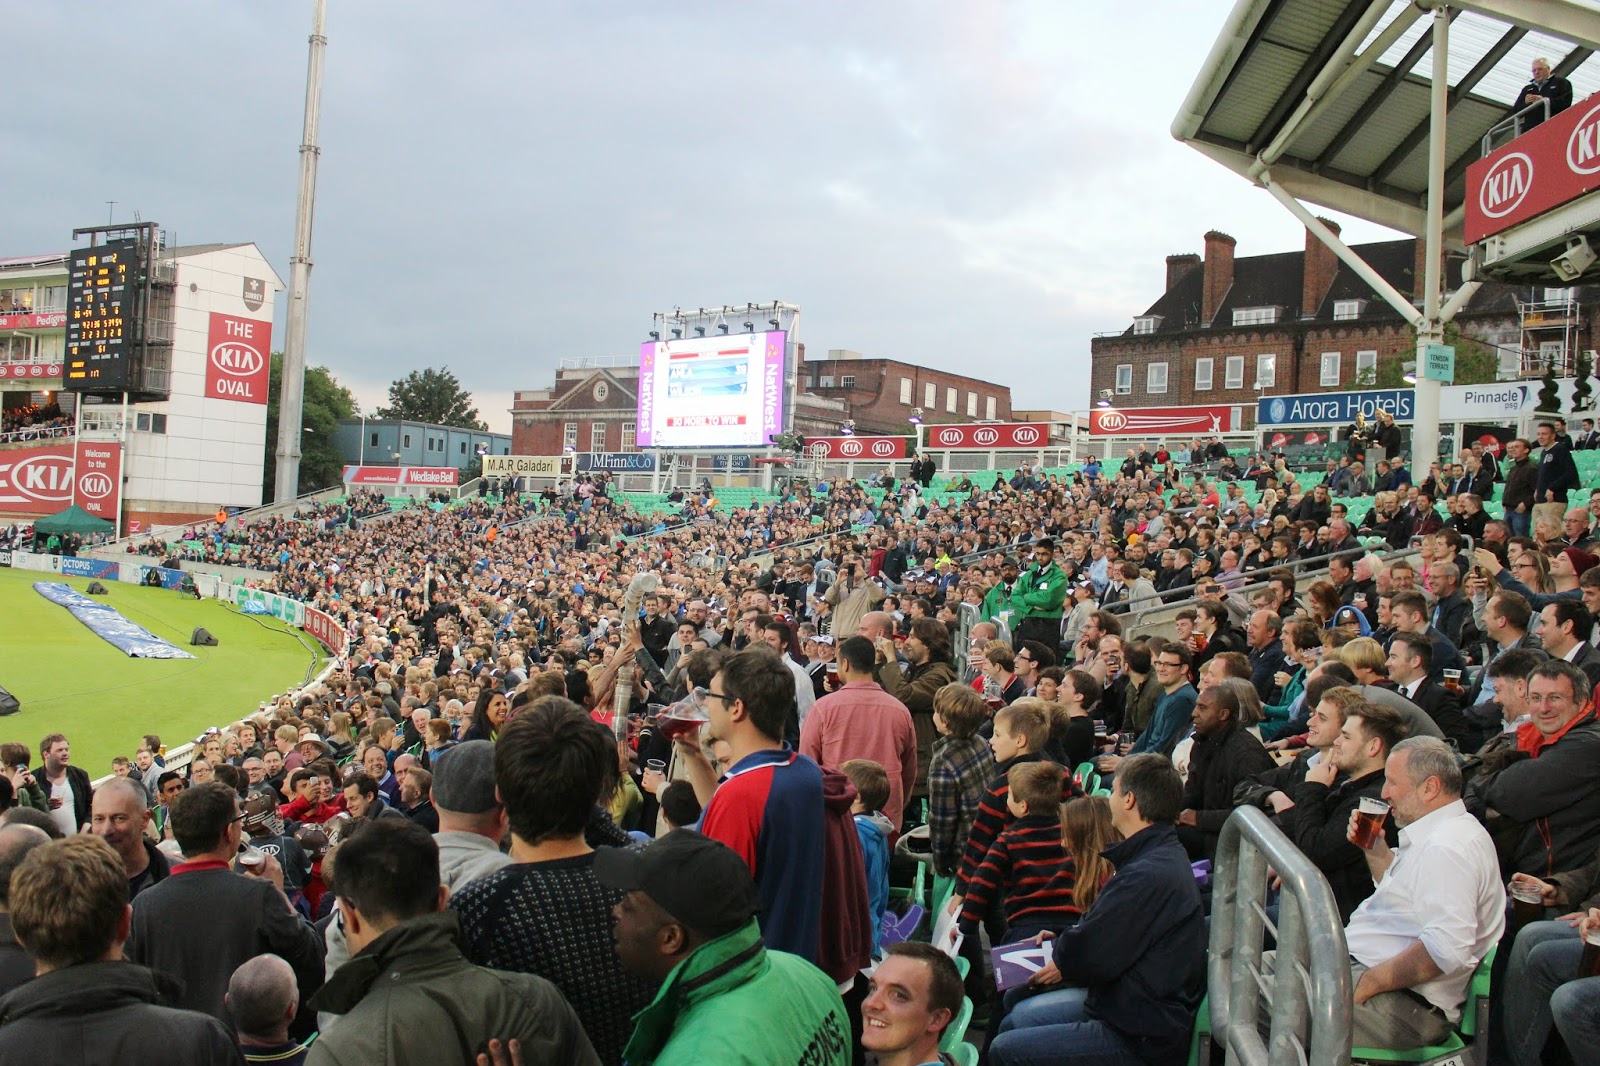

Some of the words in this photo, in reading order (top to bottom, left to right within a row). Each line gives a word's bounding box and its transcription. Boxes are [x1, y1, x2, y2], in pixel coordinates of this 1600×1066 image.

[1489, 164, 1524, 209] KIA
[245, 291, 262, 301] SURREY
[225, 319, 254, 338] THE
[220, 347, 255, 371] KIA
[216, 379, 254, 397] OVAL
[764, 363, 779, 431] NatWest
[1465, 389, 1519, 404] Pinnacle
[641, 372, 654, 434] NatWest
[1290, 399, 1339, 420] Arora
[1347, 391, 1410, 418] Hotels
[1504, 402, 1518, 410] psg
[708, 415, 720, 425] TO
[721, 415, 738, 425] WIN
[1103, 415, 1122, 427] KIA
[944, 431, 960, 442] KIA
[977, 431, 994, 441] KIA
[1017, 430, 1035, 441] KIA
[85, 449, 111, 458] Welcome
[844, 443, 859, 453] KIA
[875, 443, 891, 453] KIA
[88, 460, 95, 468] to
[96, 460, 107, 469] the
[487, 459, 514, 471] M.A.R
[517, 459, 554, 473] Galadari
[410, 471, 440, 483] Wedlake
[440, 471, 454, 483] Bell
[84, 477, 107, 493] KIA
[87, 502, 102, 511] OVAL
[63, 558, 91, 570] OCTOPUS
